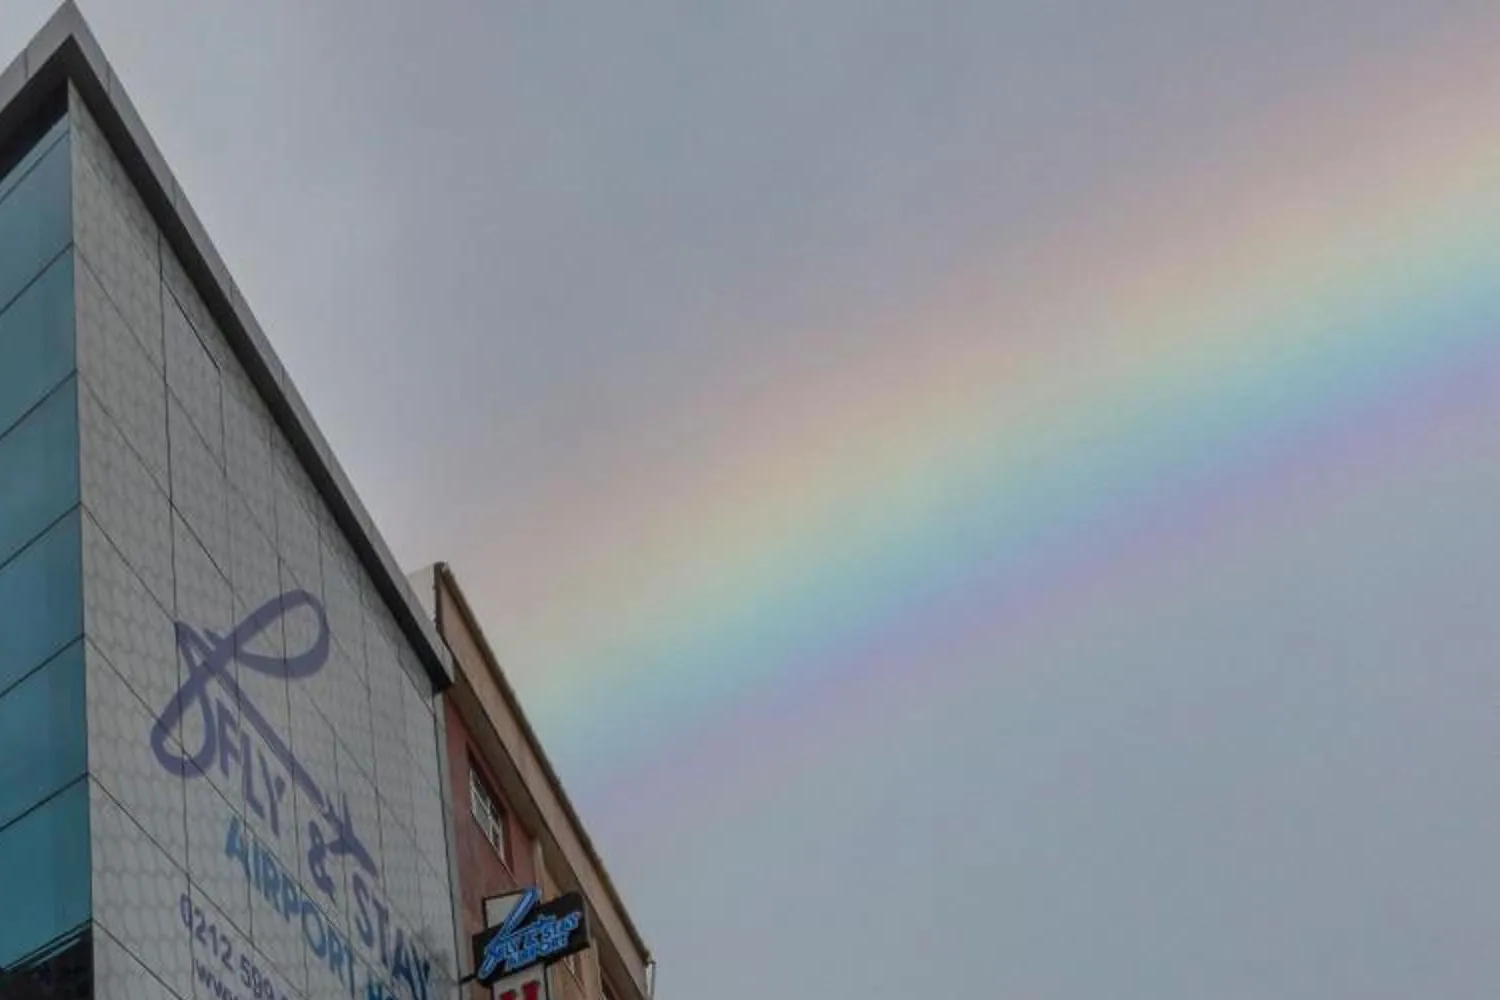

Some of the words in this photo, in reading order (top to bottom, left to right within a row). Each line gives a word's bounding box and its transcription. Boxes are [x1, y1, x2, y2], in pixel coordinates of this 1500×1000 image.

[216, 698, 285, 838] FLY
[308, 819, 336, 900] &
[179, 892, 234, 972] 0212
[225, 815, 354, 992] AIRPORT
